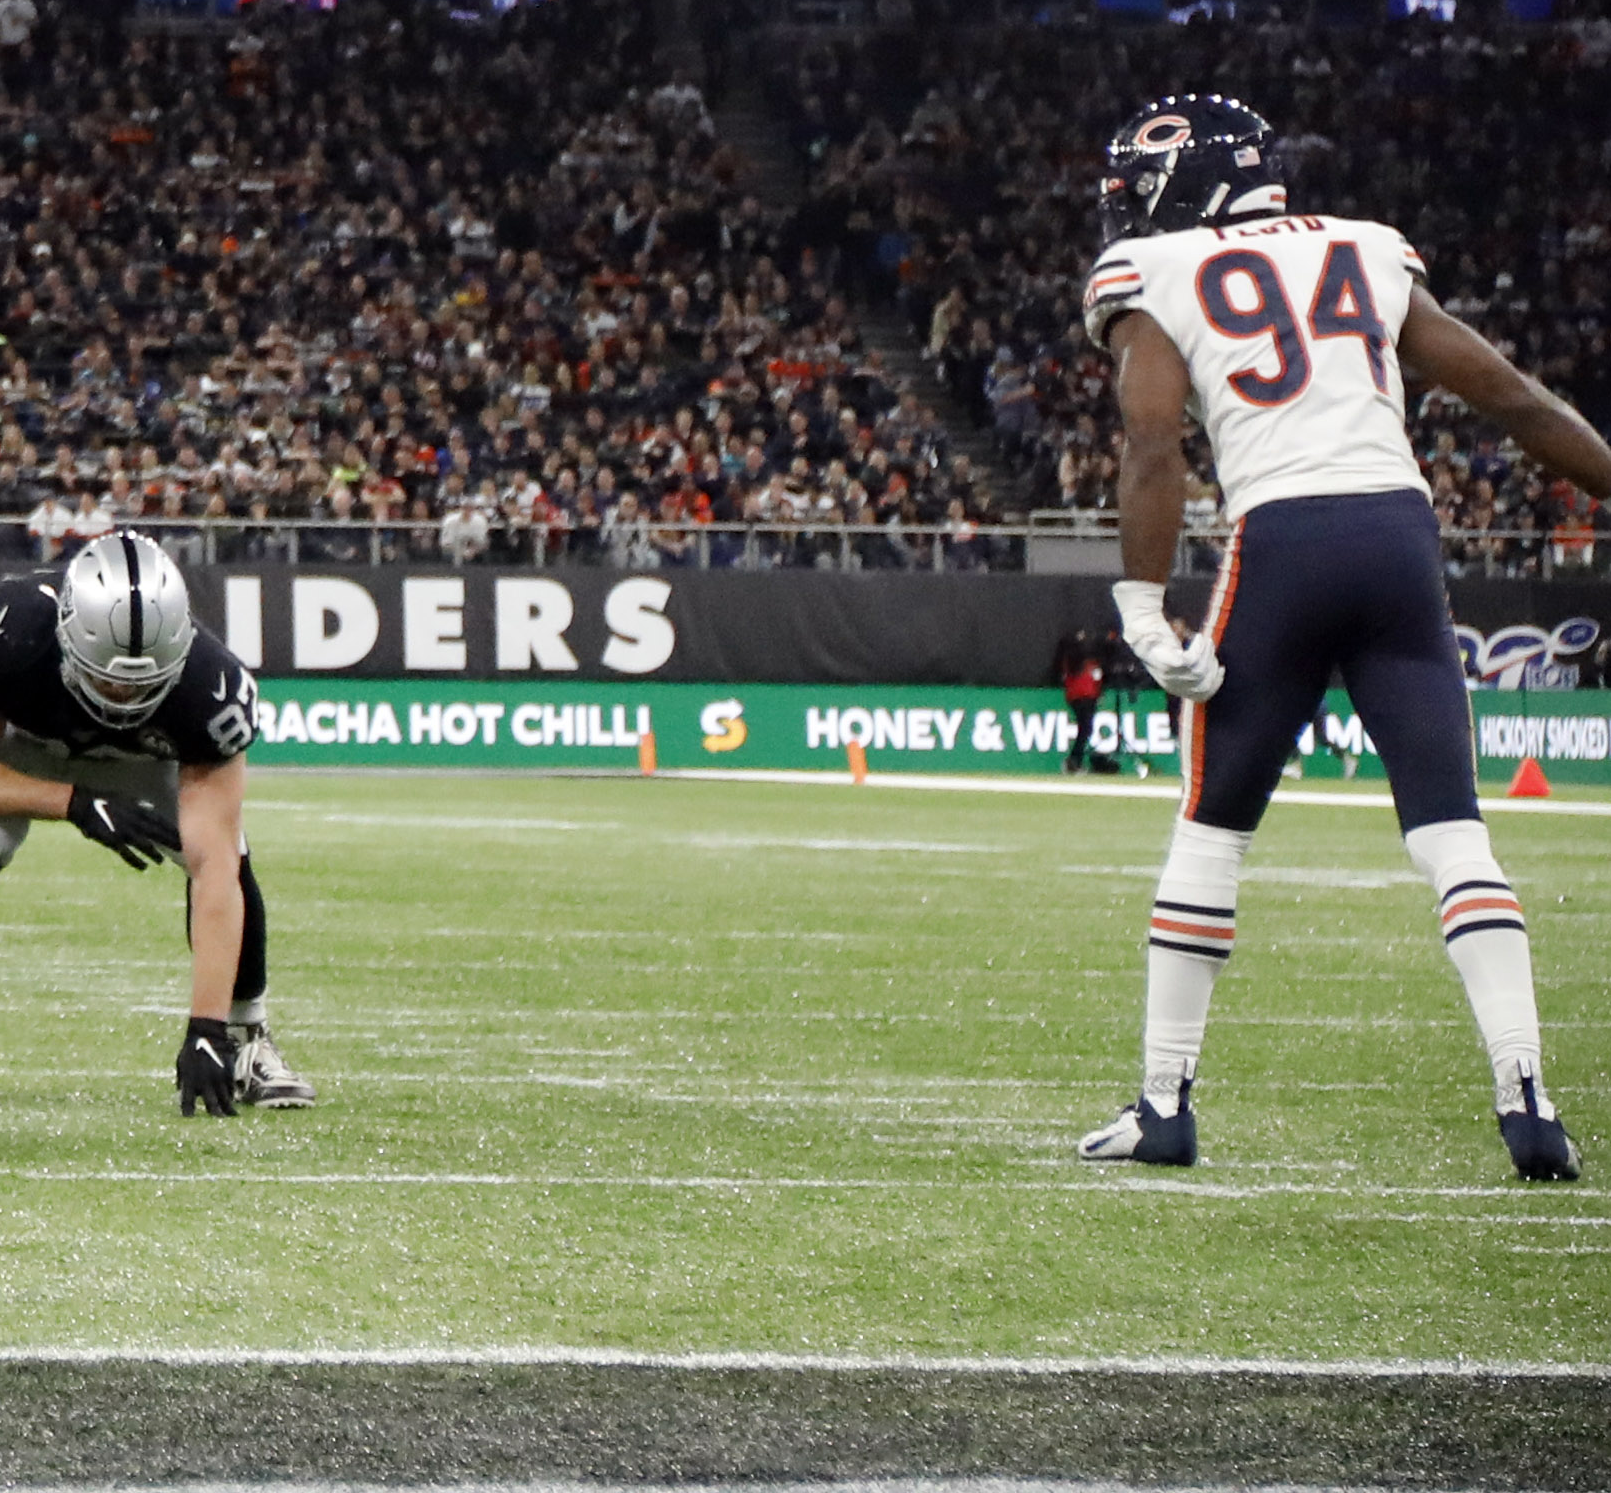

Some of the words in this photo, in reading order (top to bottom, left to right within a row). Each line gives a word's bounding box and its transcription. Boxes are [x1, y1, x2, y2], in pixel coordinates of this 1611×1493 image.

[1195, 240, 1389, 408] 94
[225, 574, 676, 674] IDERS
[258, 700, 401, 744] RACHA
[409, 702, 503, 745] HOT
[511, 703, 651, 746] CHILLI
[806, 707, 964, 750] HONEY
[971, 710, 1004, 751] &
[1480, 715, 1546, 758] HICKORY
[1547, 717, 1608, 760] SMOKED
